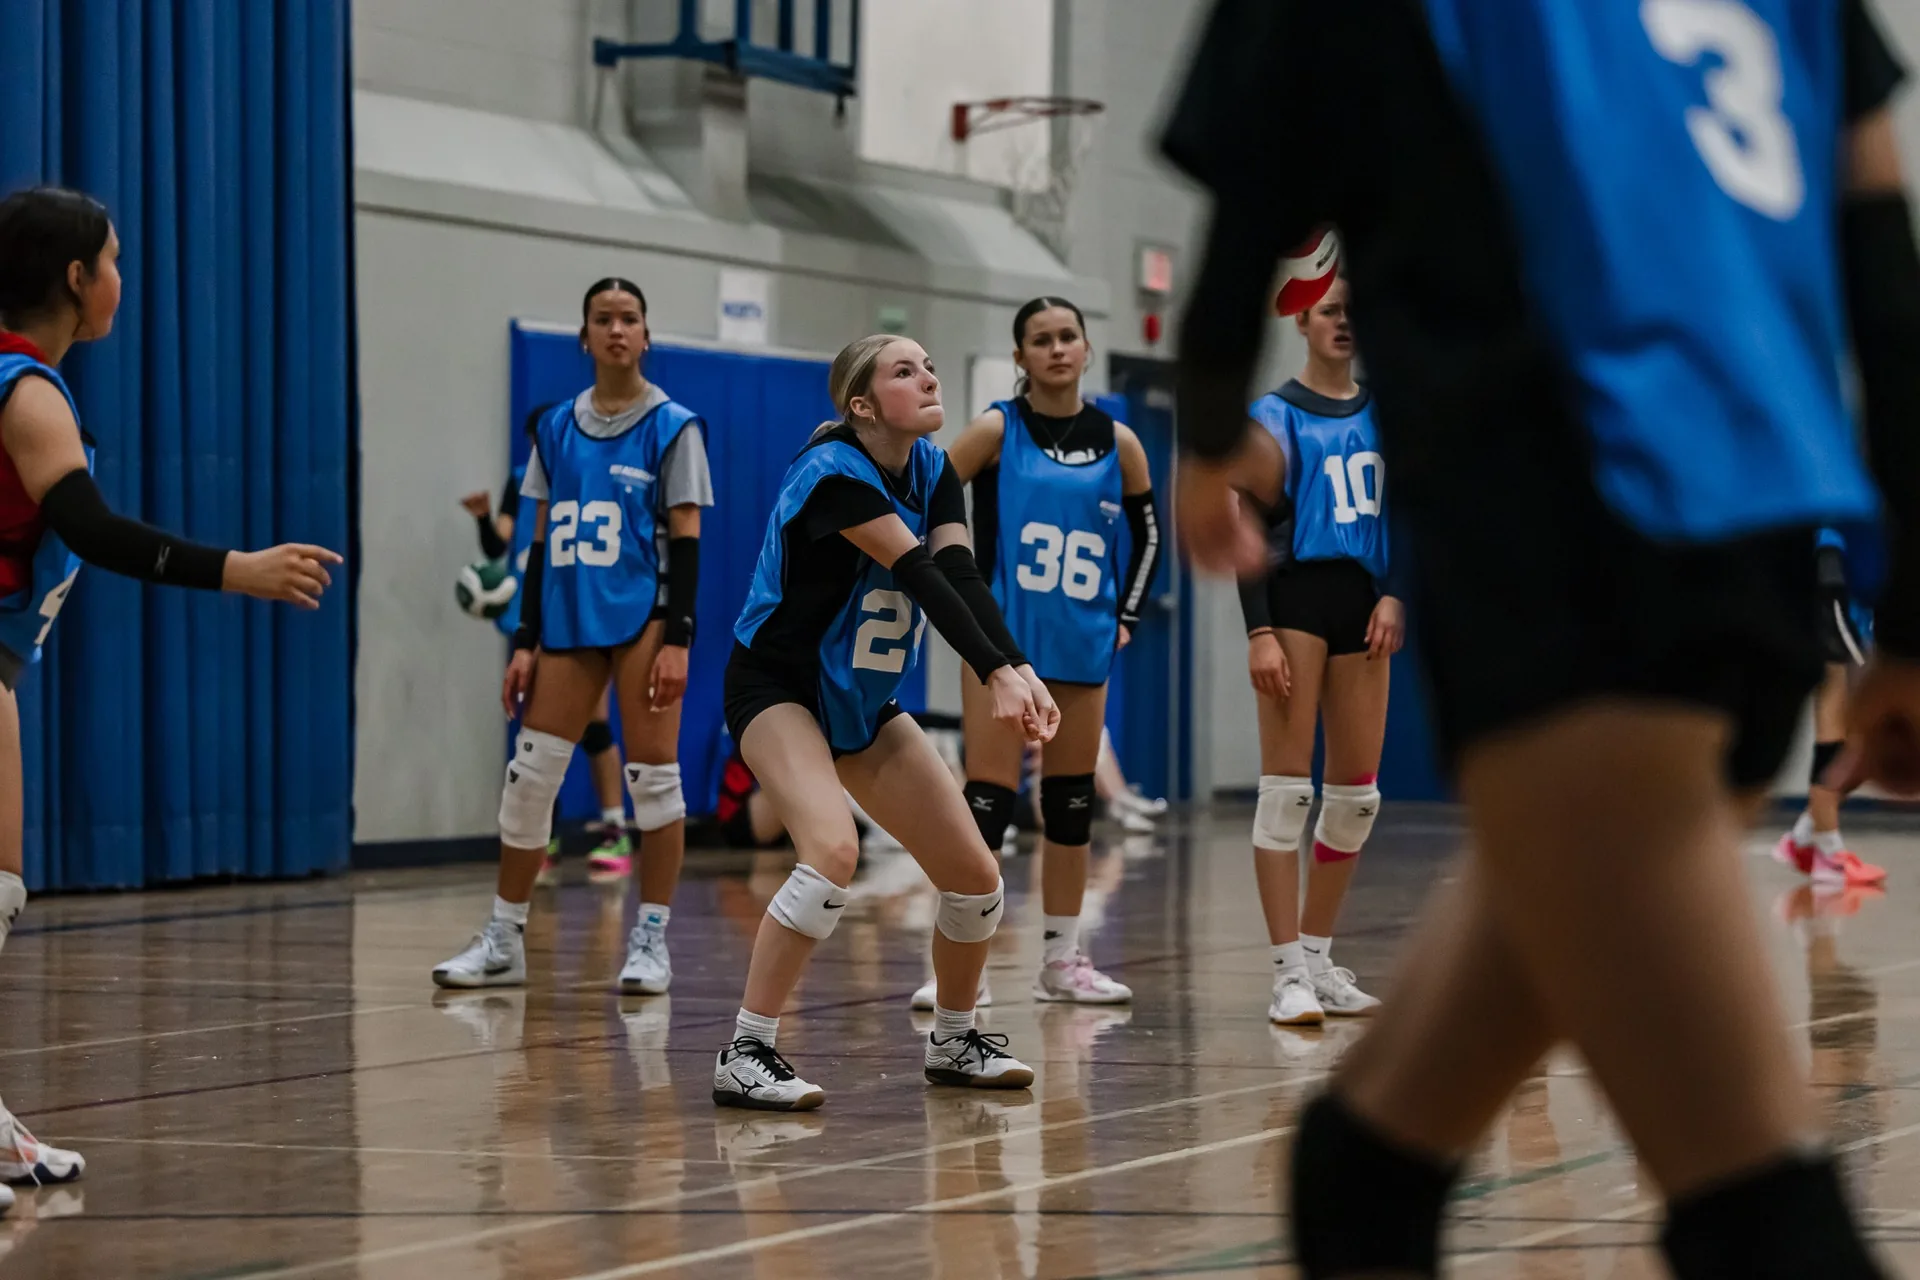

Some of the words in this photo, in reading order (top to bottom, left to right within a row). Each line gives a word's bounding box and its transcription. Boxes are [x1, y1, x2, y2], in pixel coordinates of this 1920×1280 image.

[1639, 0, 1806, 222] 3
[1324, 451, 1385, 524] 10
[551, 500, 621, 568] 23
[1017, 522, 1105, 600] 36
